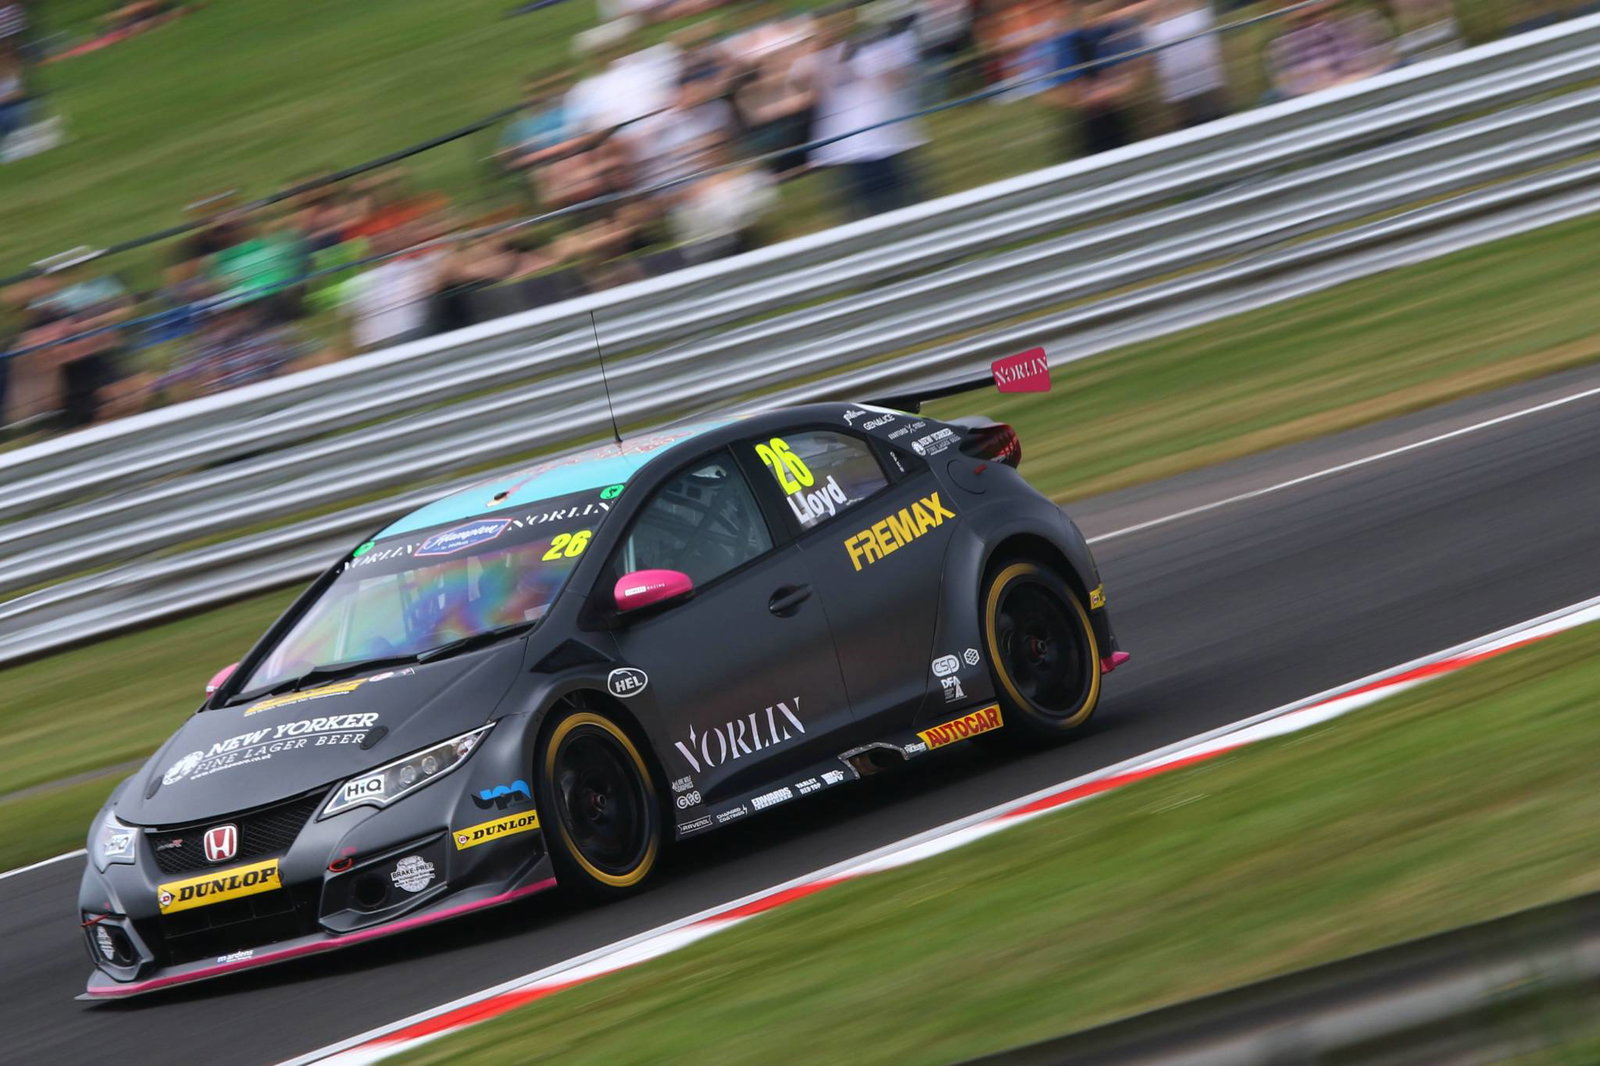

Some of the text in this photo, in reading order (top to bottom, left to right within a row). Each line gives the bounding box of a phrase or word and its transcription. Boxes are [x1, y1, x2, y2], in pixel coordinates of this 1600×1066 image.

[995, 356, 1048, 386] NORLIN
[754, 437, 815, 496] 26
[507, 500, 615, 531] NORLIN
[786, 474, 848, 526] Lloyd
[541, 530, 592, 561] 26
[844, 491, 956, 572] FREMAX
[614, 675, 643, 693] HEL
[205, 713, 379, 759] NEW YORKER
[674, 696, 806, 773] NORLIN
[924, 707, 1000, 748] AUTOCAR
[194, 753, 238, 774] FINE
[243, 739, 307, 759] LAGER
[315, 733, 365, 747] BEER
[346, 778, 382, 798] HiQ
[472, 814, 536, 841] DUNLOP
[178, 866, 276, 902] DUNLOP
[392, 862, 434, 880] BRAKE-PREP
